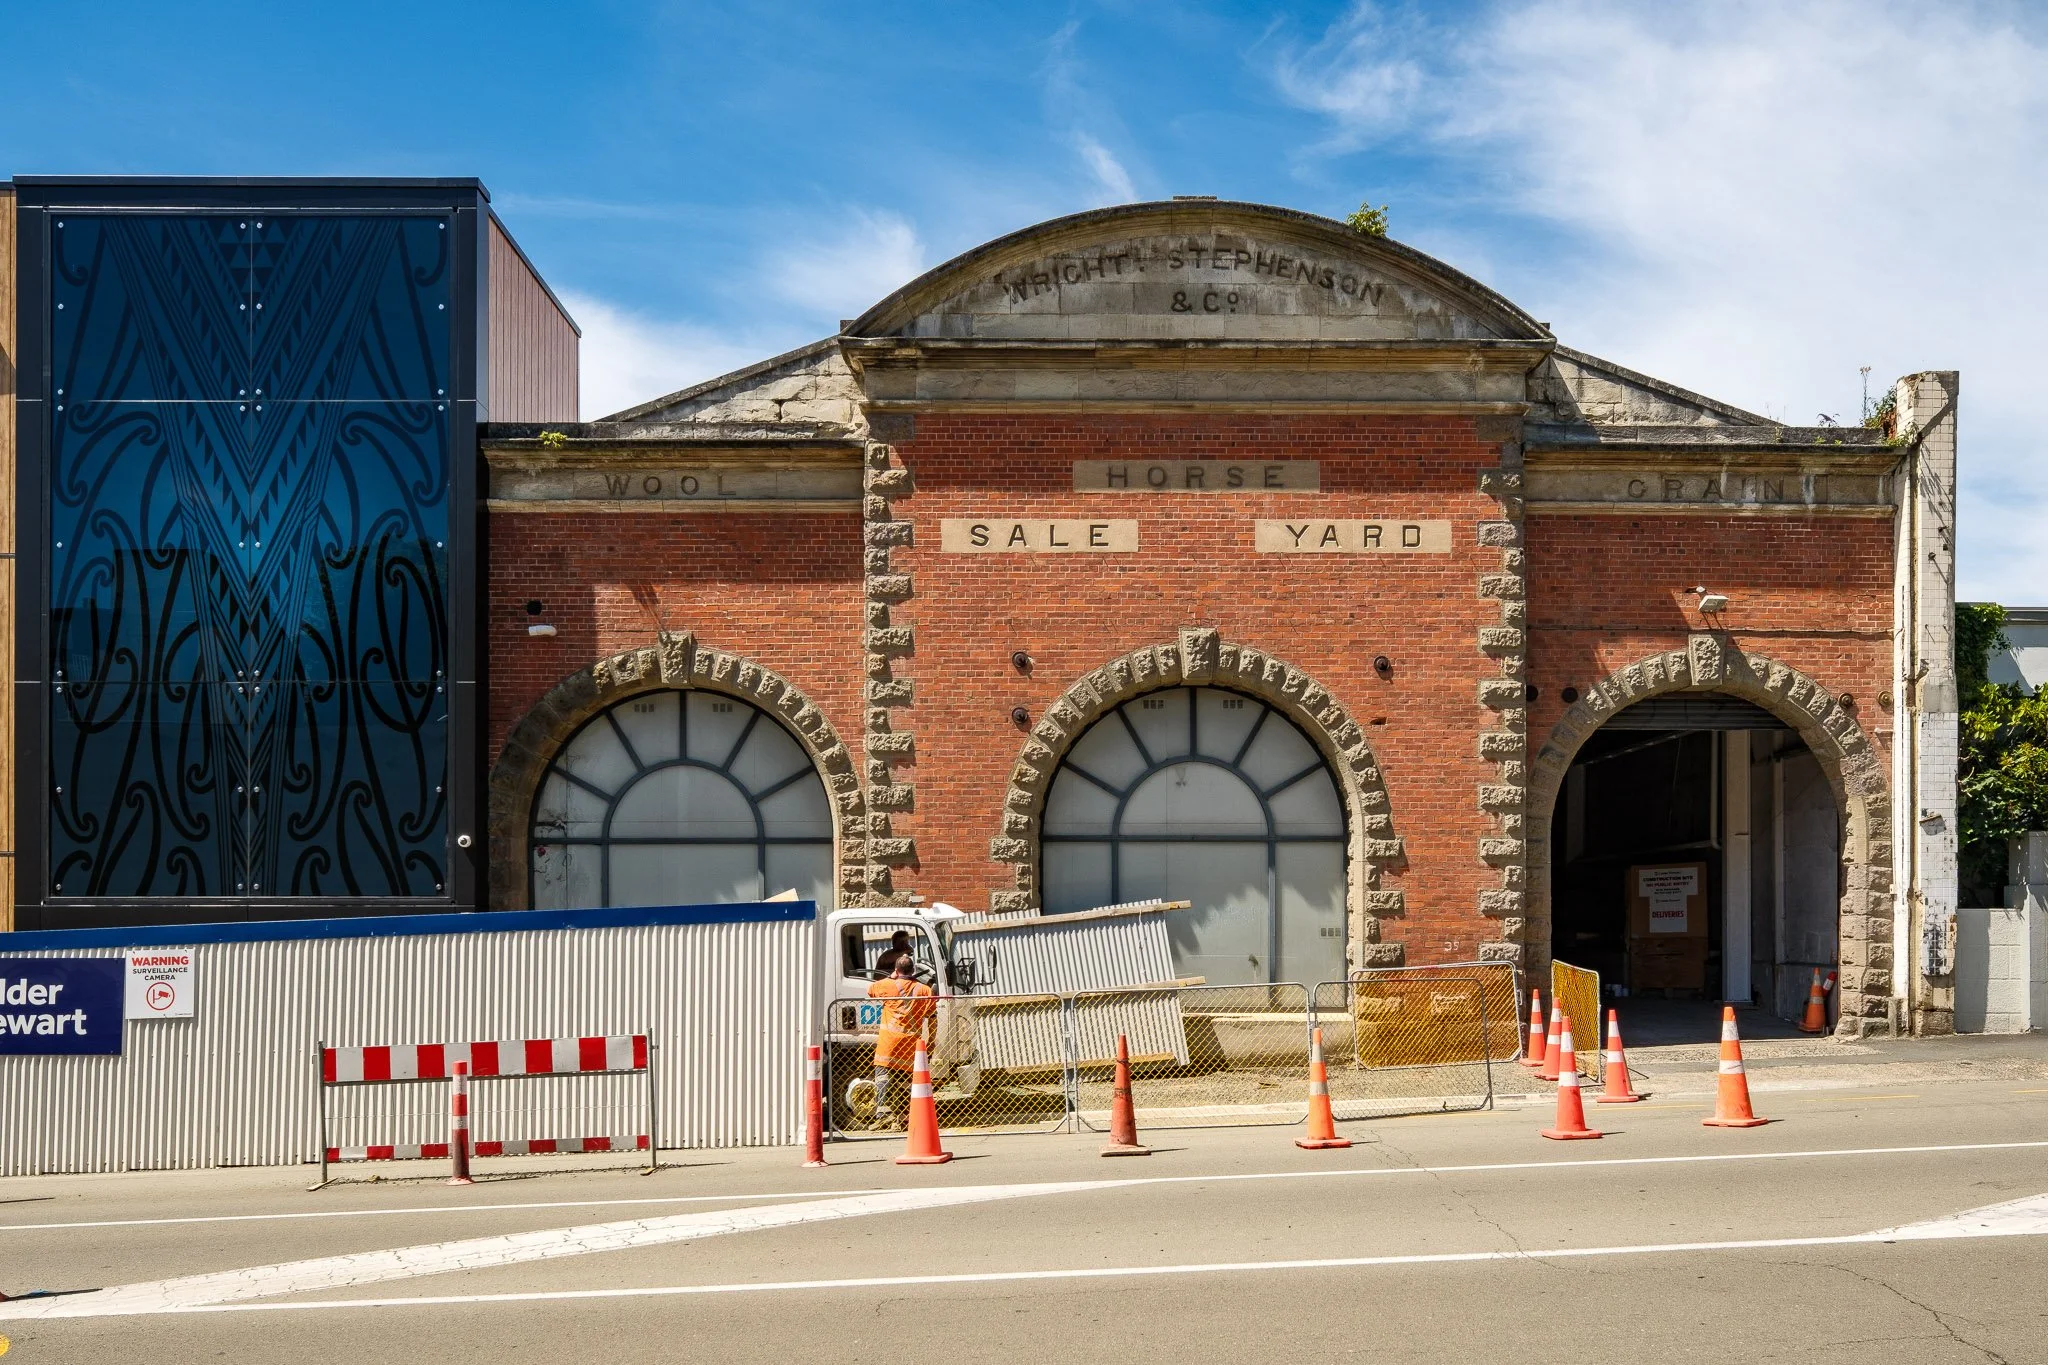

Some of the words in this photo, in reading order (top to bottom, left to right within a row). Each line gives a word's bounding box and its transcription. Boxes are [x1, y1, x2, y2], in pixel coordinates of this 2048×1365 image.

[1168, 247, 1384, 306] STEPHENSON
[1171, 290, 1192, 313] &
[603, 473, 737, 496] WOOL
[1106, 464, 1286, 489] HORSE
[1627, 478, 1785, 500] GRAIN
[969, 523, 1111, 548] SALE
[1285, 523, 1423, 549] YARD
[1652, 910, 1685, 918] DELIVERIES
[132, 956, 189, 966] WARNING
